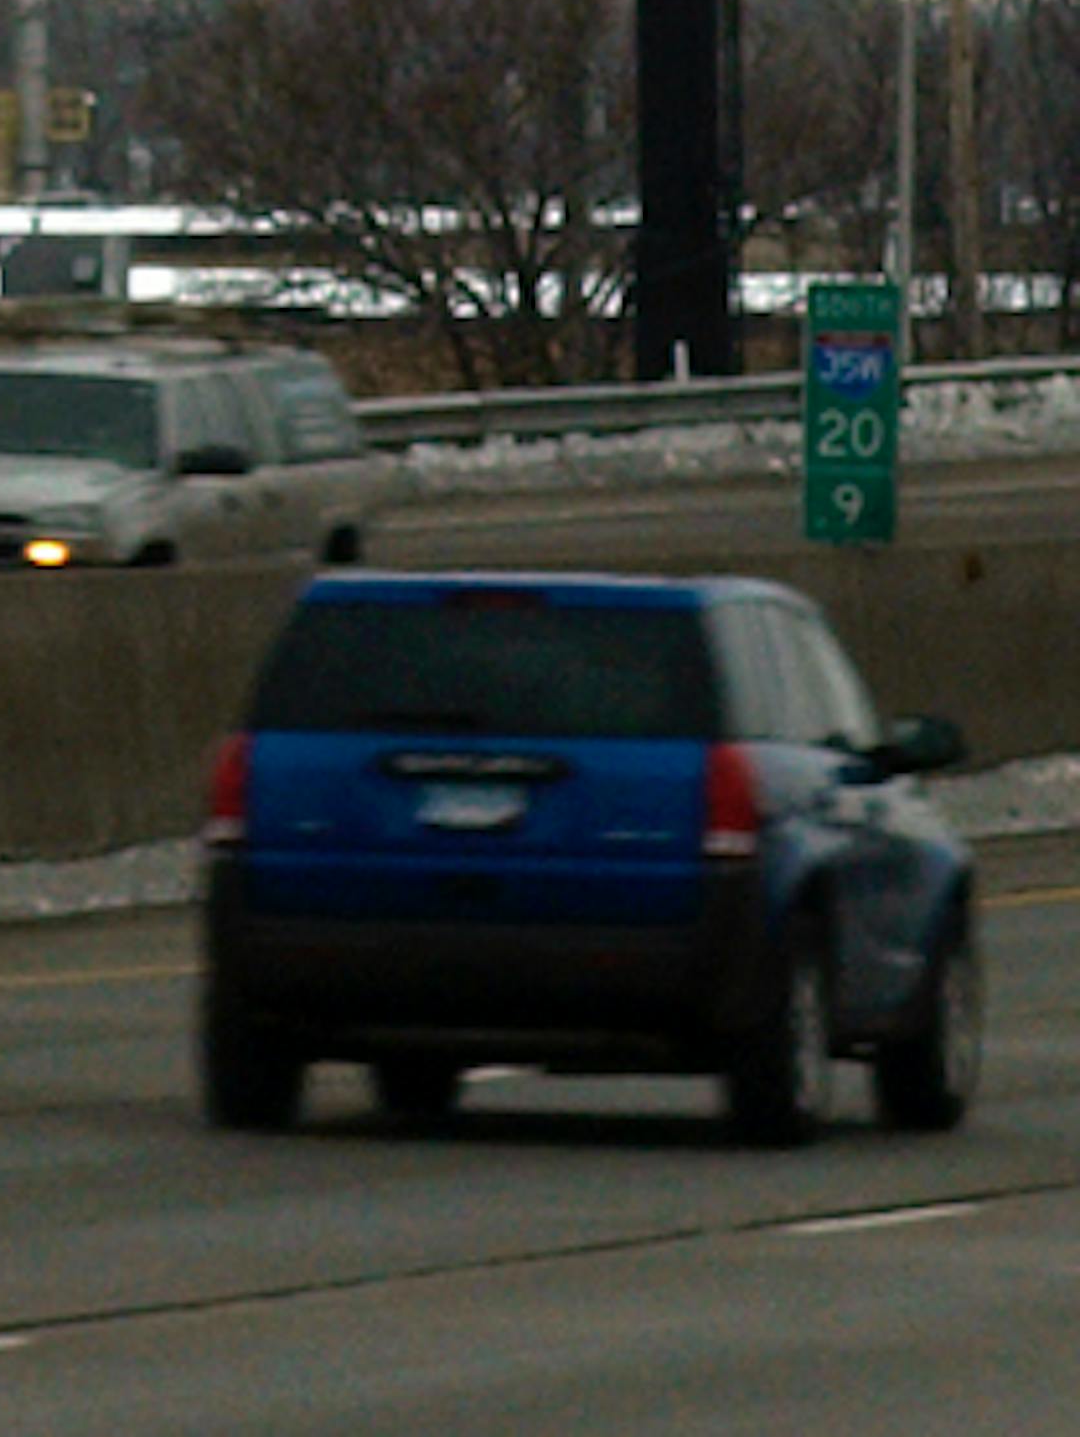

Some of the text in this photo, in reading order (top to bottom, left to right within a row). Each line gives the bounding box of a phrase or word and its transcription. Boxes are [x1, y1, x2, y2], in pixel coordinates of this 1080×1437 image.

[819, 348, 884, 383] 35W
[817, 408, 885, 457] 20
[832, 483, 865, 525] 9
